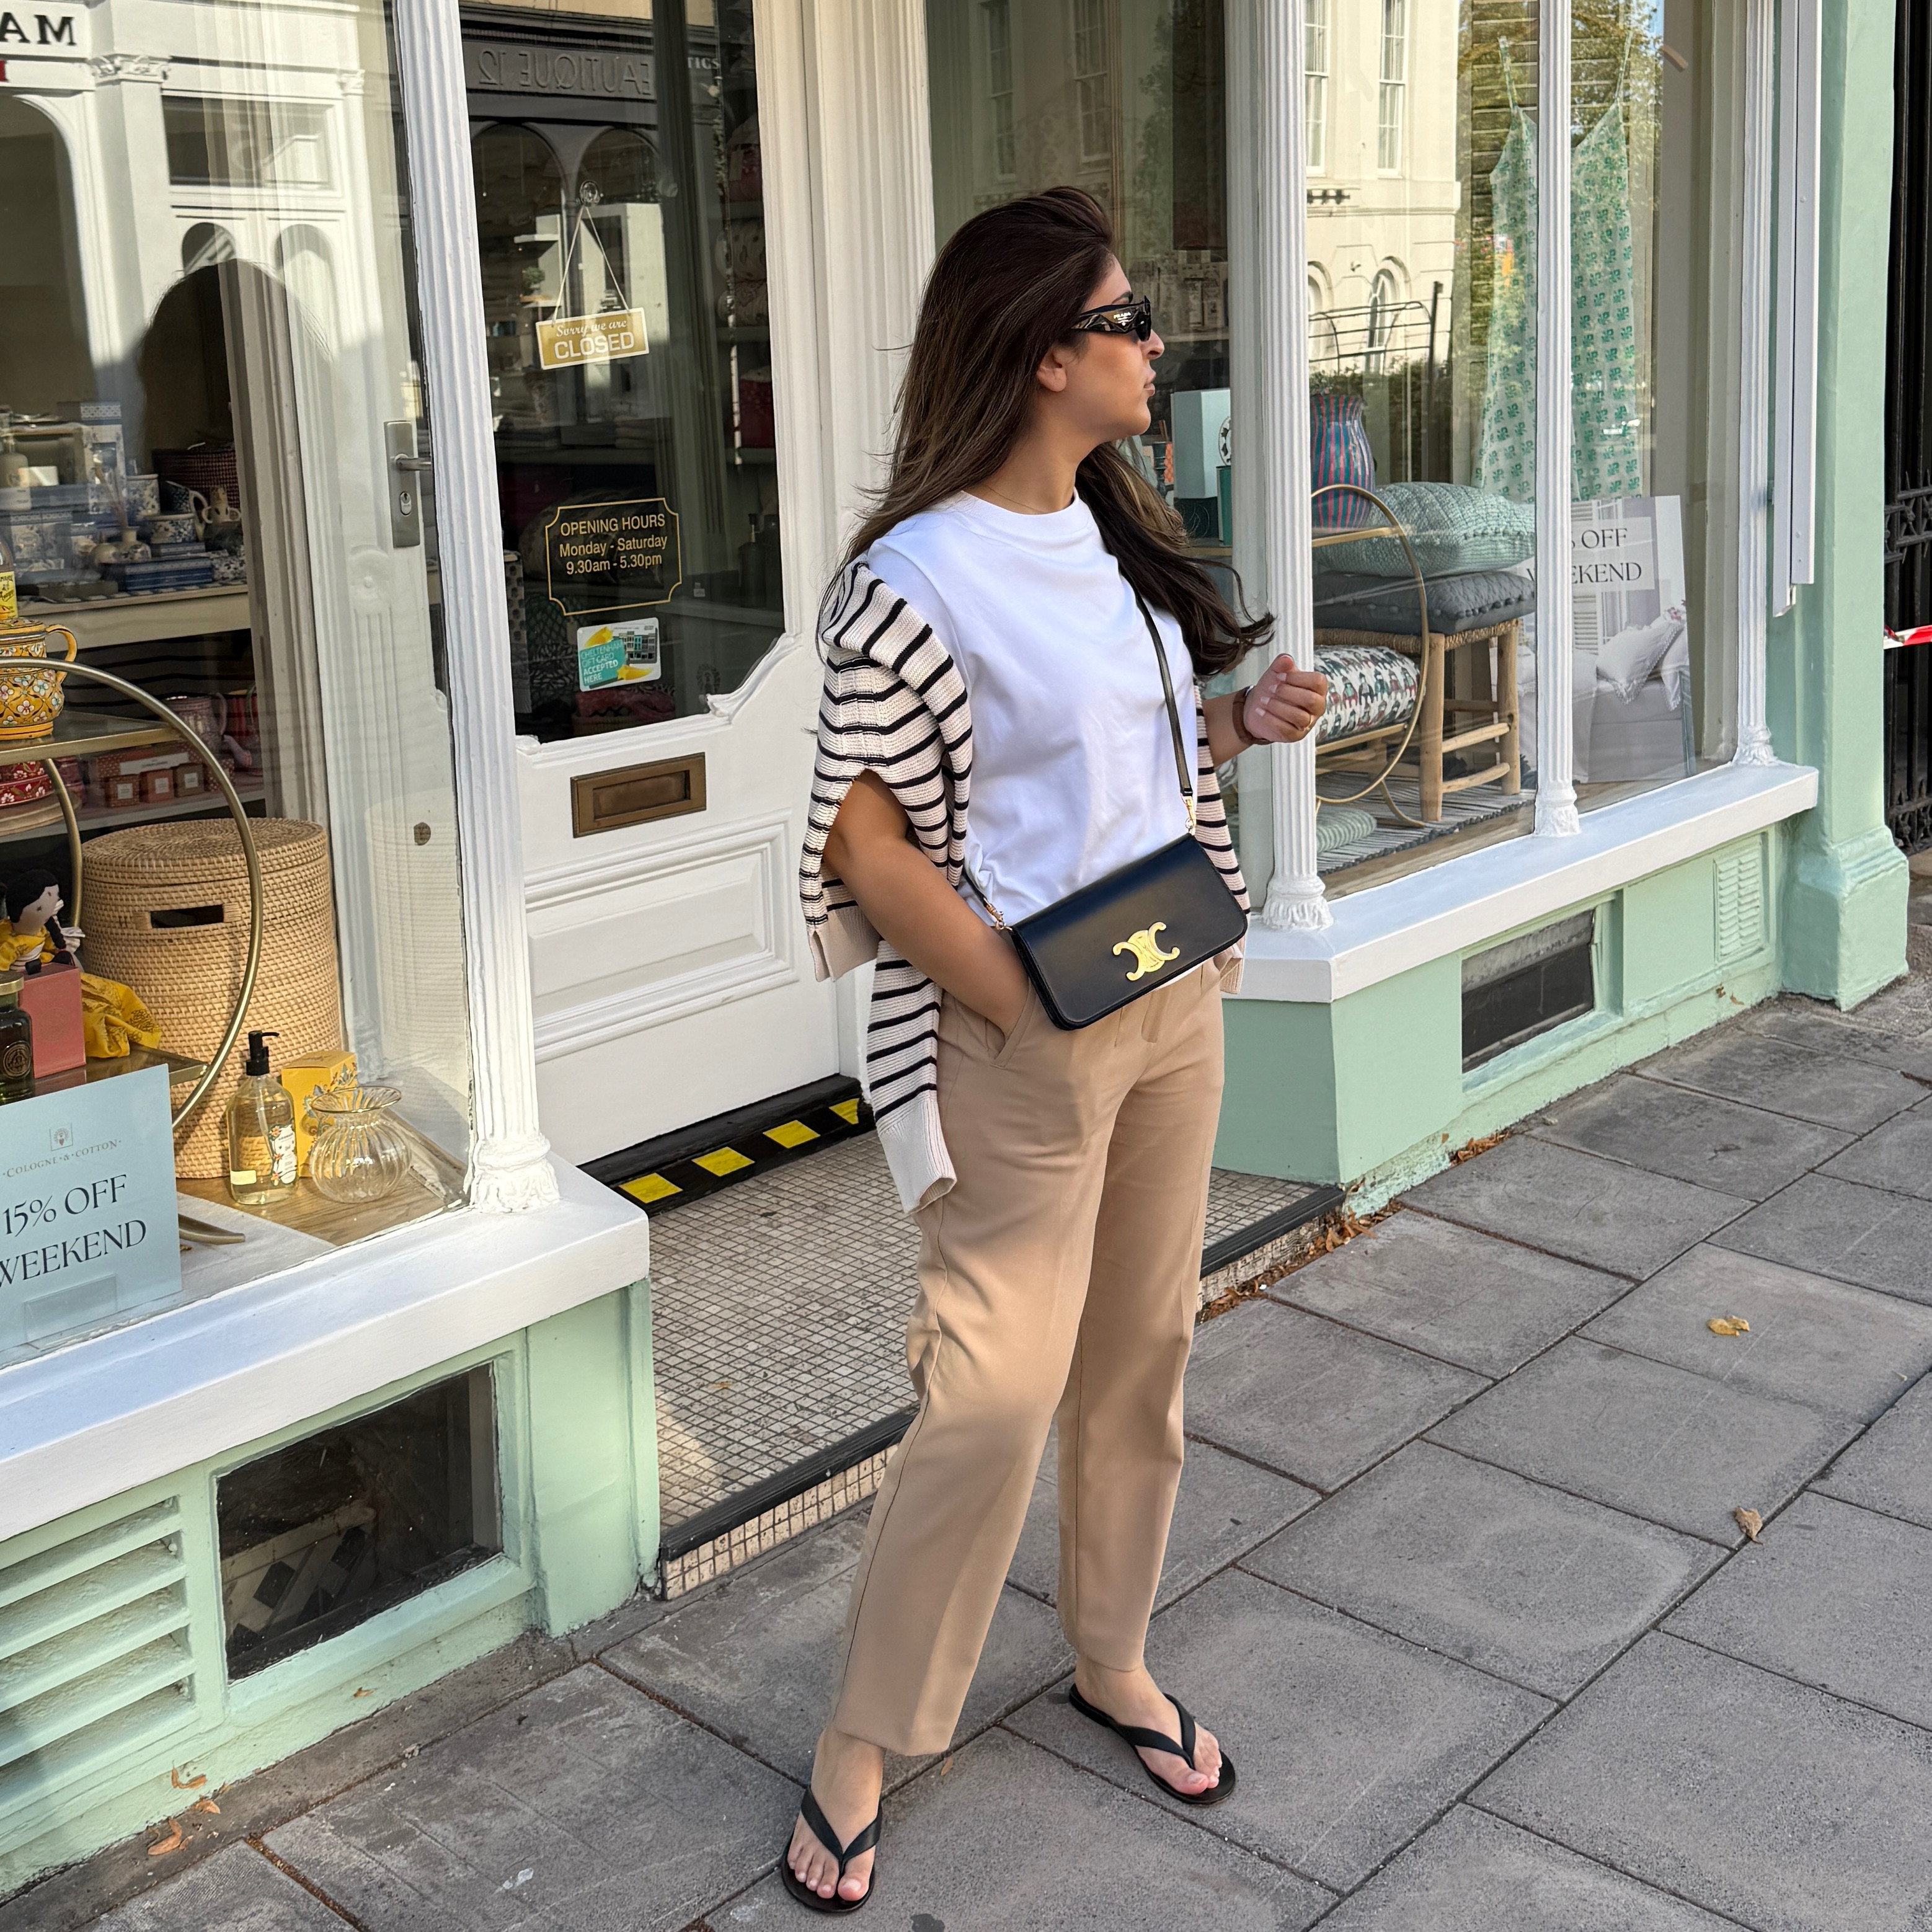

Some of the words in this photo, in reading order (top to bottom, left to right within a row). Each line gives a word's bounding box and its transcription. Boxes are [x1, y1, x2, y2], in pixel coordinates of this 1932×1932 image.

[556, 324, 589, 337] Sorry
[591, 322, 606, 332] we
[608, 319, 627, 329] are
[554, 331, 635, 360] CLOSED
[560, 518, 619, 536] OPENING
[622, 513, 665, 531] HOURS
[559, 541, 607, 558] Monday
[617, 534, 668, 551] Saturday
[1581, 528, 1628, 549] OFF
[565, 559, 611, 575] 9.30am
[619, 553, 662, 569] 5.30pm
[583, 659, 619, 676] ACCEPTED
[596, 652, 614, 663] CARD
[583, 672, 603, 683] HERE
[3, 1195, 57, 1238] 15%
[64, 1174, 127, 1215] OFF
